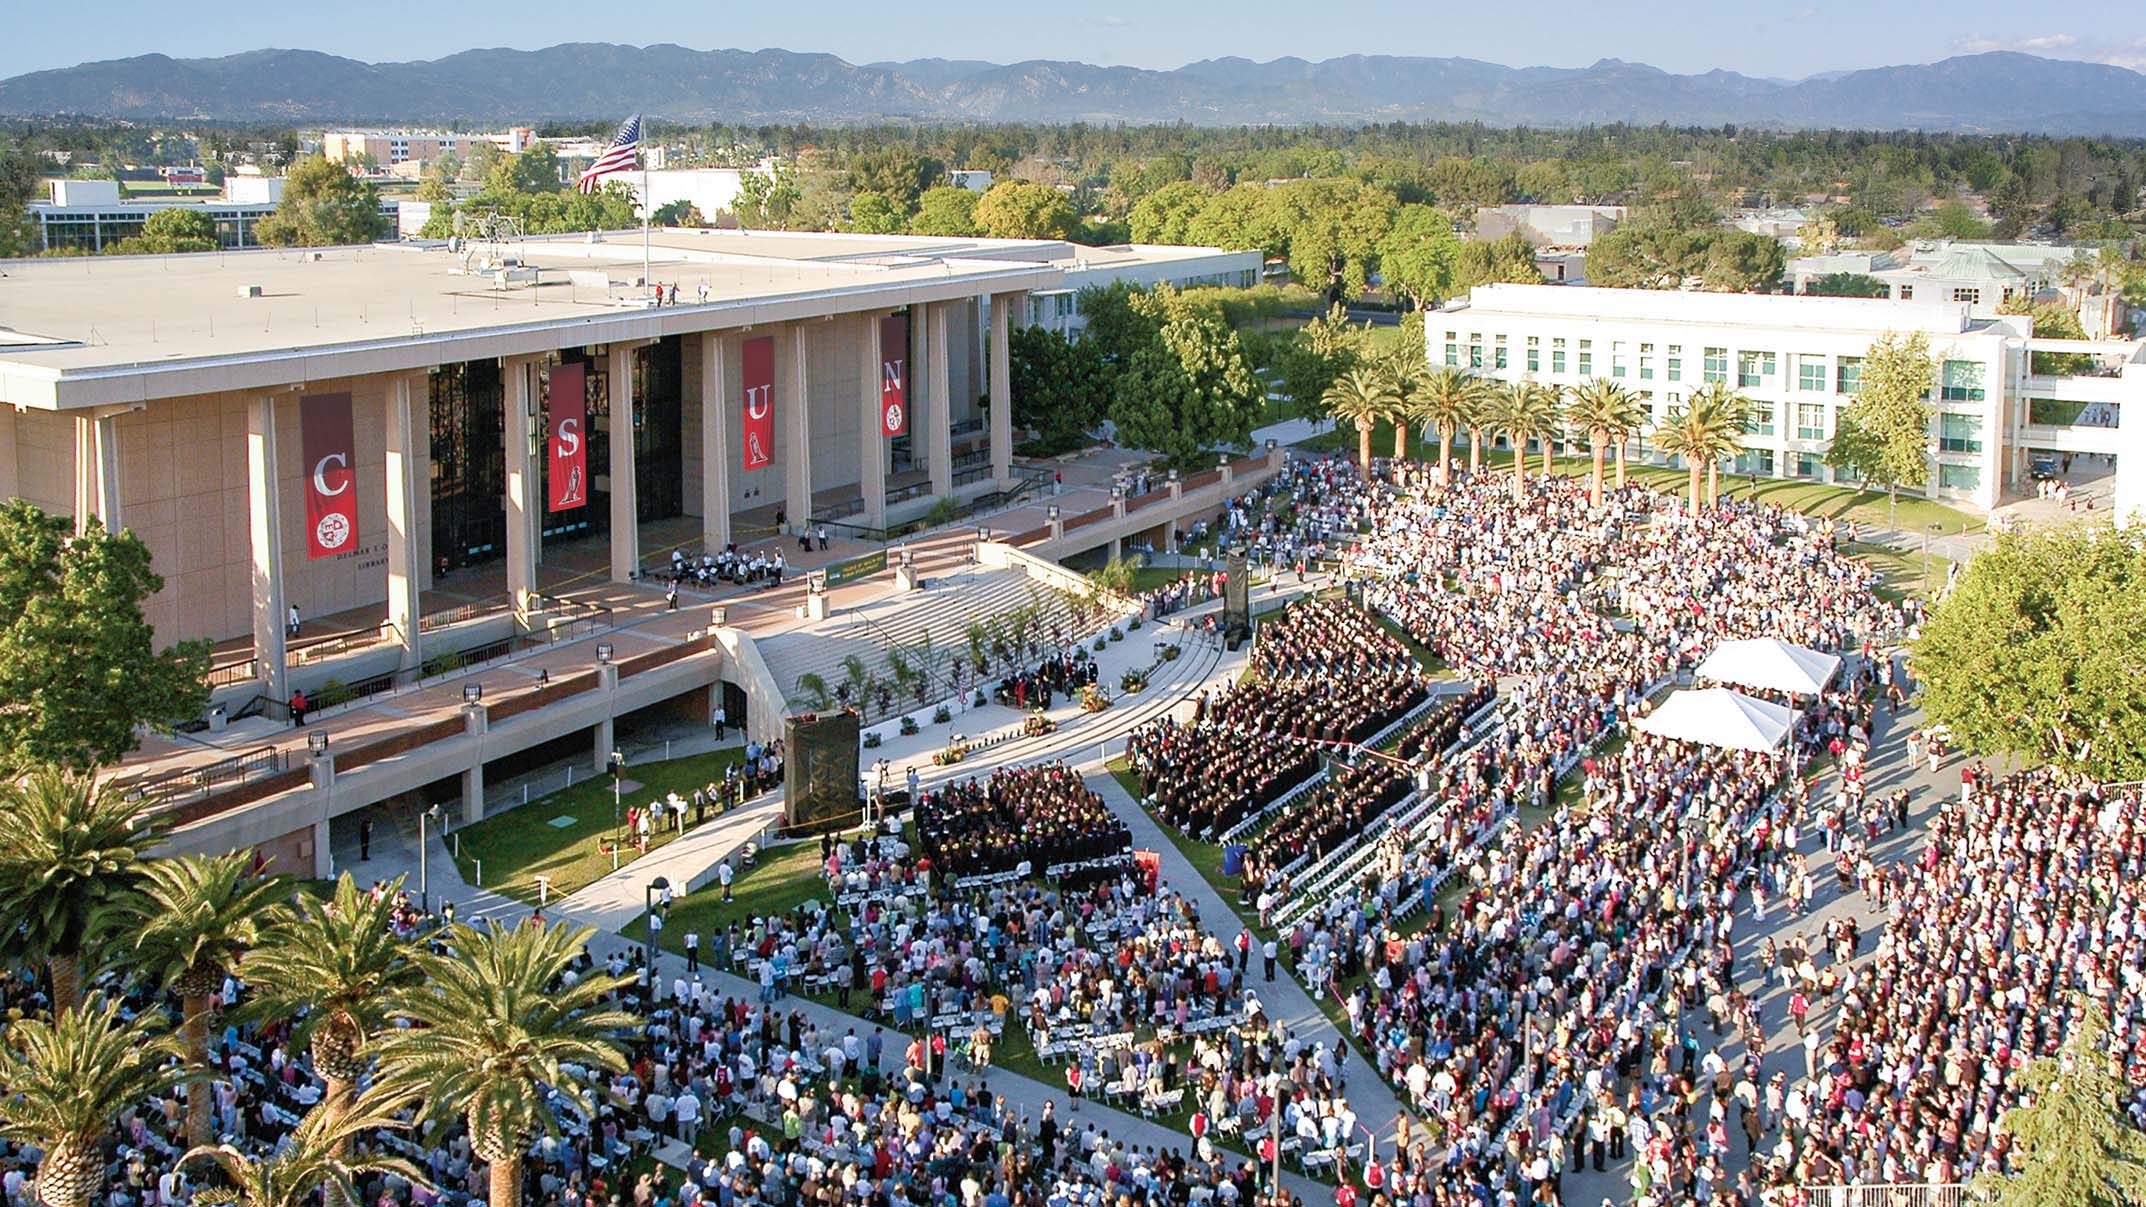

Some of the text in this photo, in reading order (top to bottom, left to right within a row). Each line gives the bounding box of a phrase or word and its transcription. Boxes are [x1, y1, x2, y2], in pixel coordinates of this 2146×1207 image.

[884, 360, 902, 392] N
[747, 384, 770, 419] U
[558, 418, 579, 458] S
[314, 452, 348, 496] C
